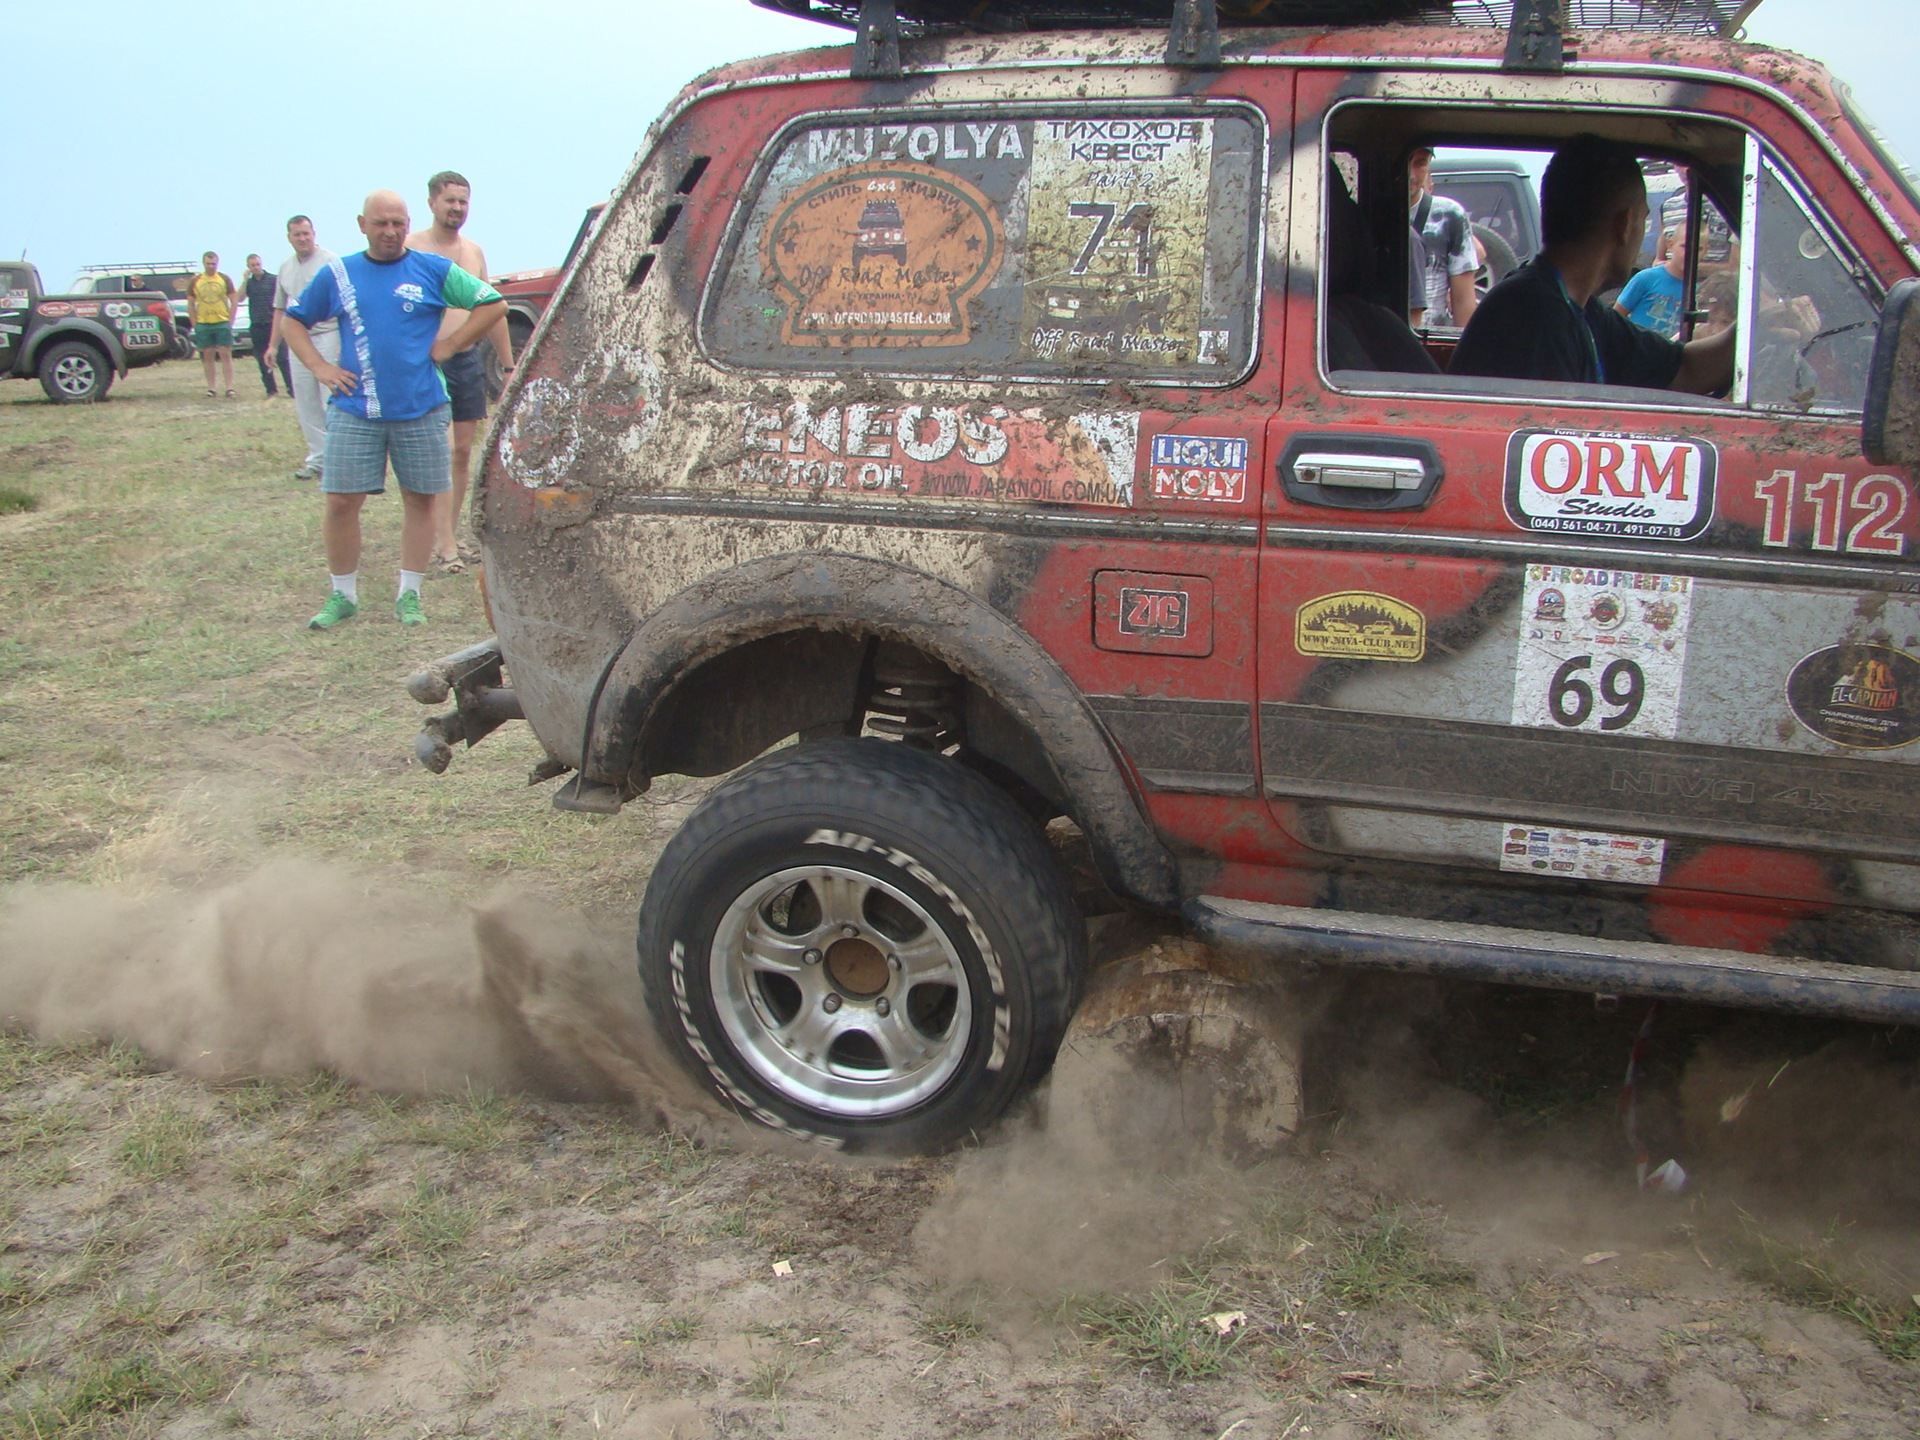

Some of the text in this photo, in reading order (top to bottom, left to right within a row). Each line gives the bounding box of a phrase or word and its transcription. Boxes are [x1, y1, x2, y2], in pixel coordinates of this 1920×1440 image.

[808, 124, 1025, 164] MUZOLYA
[1047, 121, 1198, 143] ТИХОХОД
[1071, 142, 1171, 161] КВЕСТ
[1084, 172, 1155, 188] Part 2
[808, 184, 862, 209] СТИЛЬ
[1067, 201, 1152, 275] 71
[839, 265, 883, 289] Road
[894, 263, 961, 288] Master
[857, 292, 901, 300] УКРАИНА
[128, 320, 155, 330] BTR
[129, 334, 160, 346] ARB
[740, 401, 1009, 465] ENEOS
[1554, 429, 1590, 440] Tunig
[1156, 435, 1241, 469] LIQUI
[738, 458, 909, 490] MOTOR OIL
[1531, 438, 1692, 500] ORM
[1155, 468, 1242, 498] MOLY
[1558, 498, 1656, 519] Studio
[1755, 469, 1907, 556] 112
[1530, 517, 1681, 537] (044) 561-04-71, 491-07-18
[1530, 565, 1691, 593] OFFROAD FREEFEST
[1128, 594, 1181, 629] ZIC
[1303, 634, 1417, 650] WWW.NIVA-CLUB.NET
[1549, 655, 1645, 731] 69
[1611, 769, 1755, 803] NIVA
